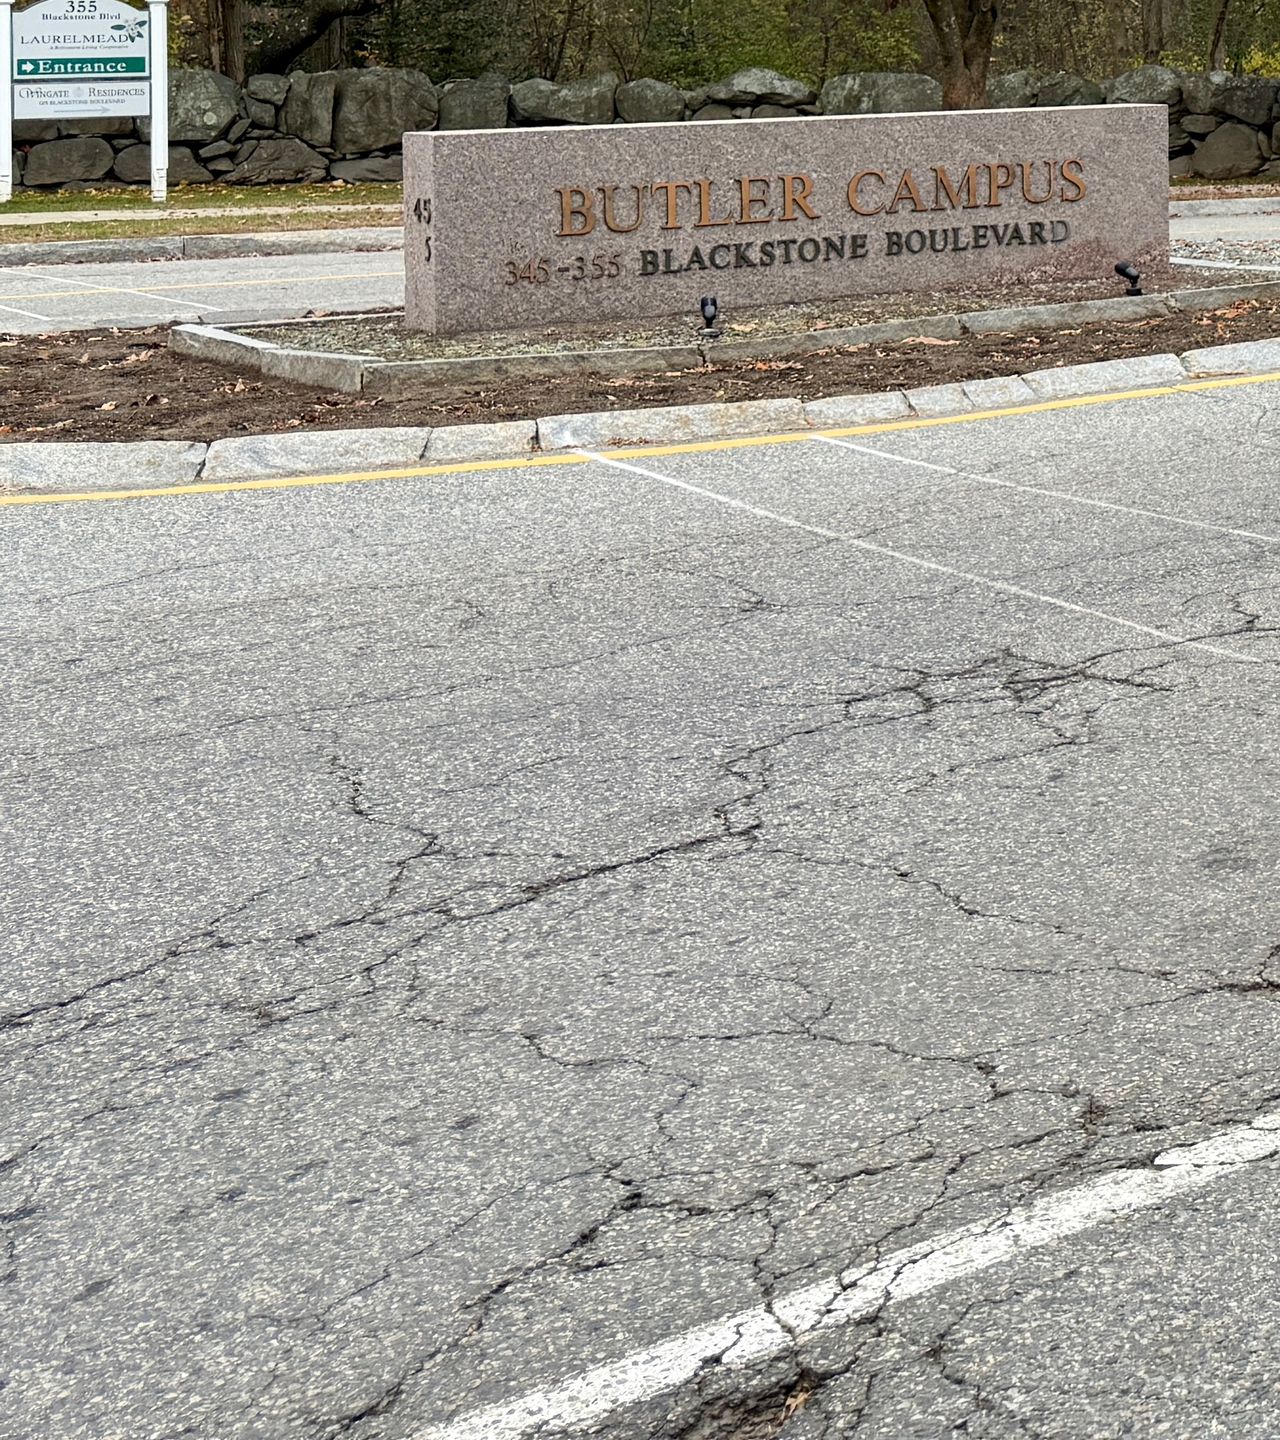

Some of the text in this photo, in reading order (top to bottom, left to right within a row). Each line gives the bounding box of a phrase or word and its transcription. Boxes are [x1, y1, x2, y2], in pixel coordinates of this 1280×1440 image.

[66, 0, 97, 13] 355
[21, 34, 129, 44] LAURELMEAD
[37, 60, 127, 73] Entrance
[554, 159, 1088, 237] BUTLER CAMPUS
[639, 233, 869, 276] BLACKSTONE
[885, 219, 1071, 257] BOULEVARD
